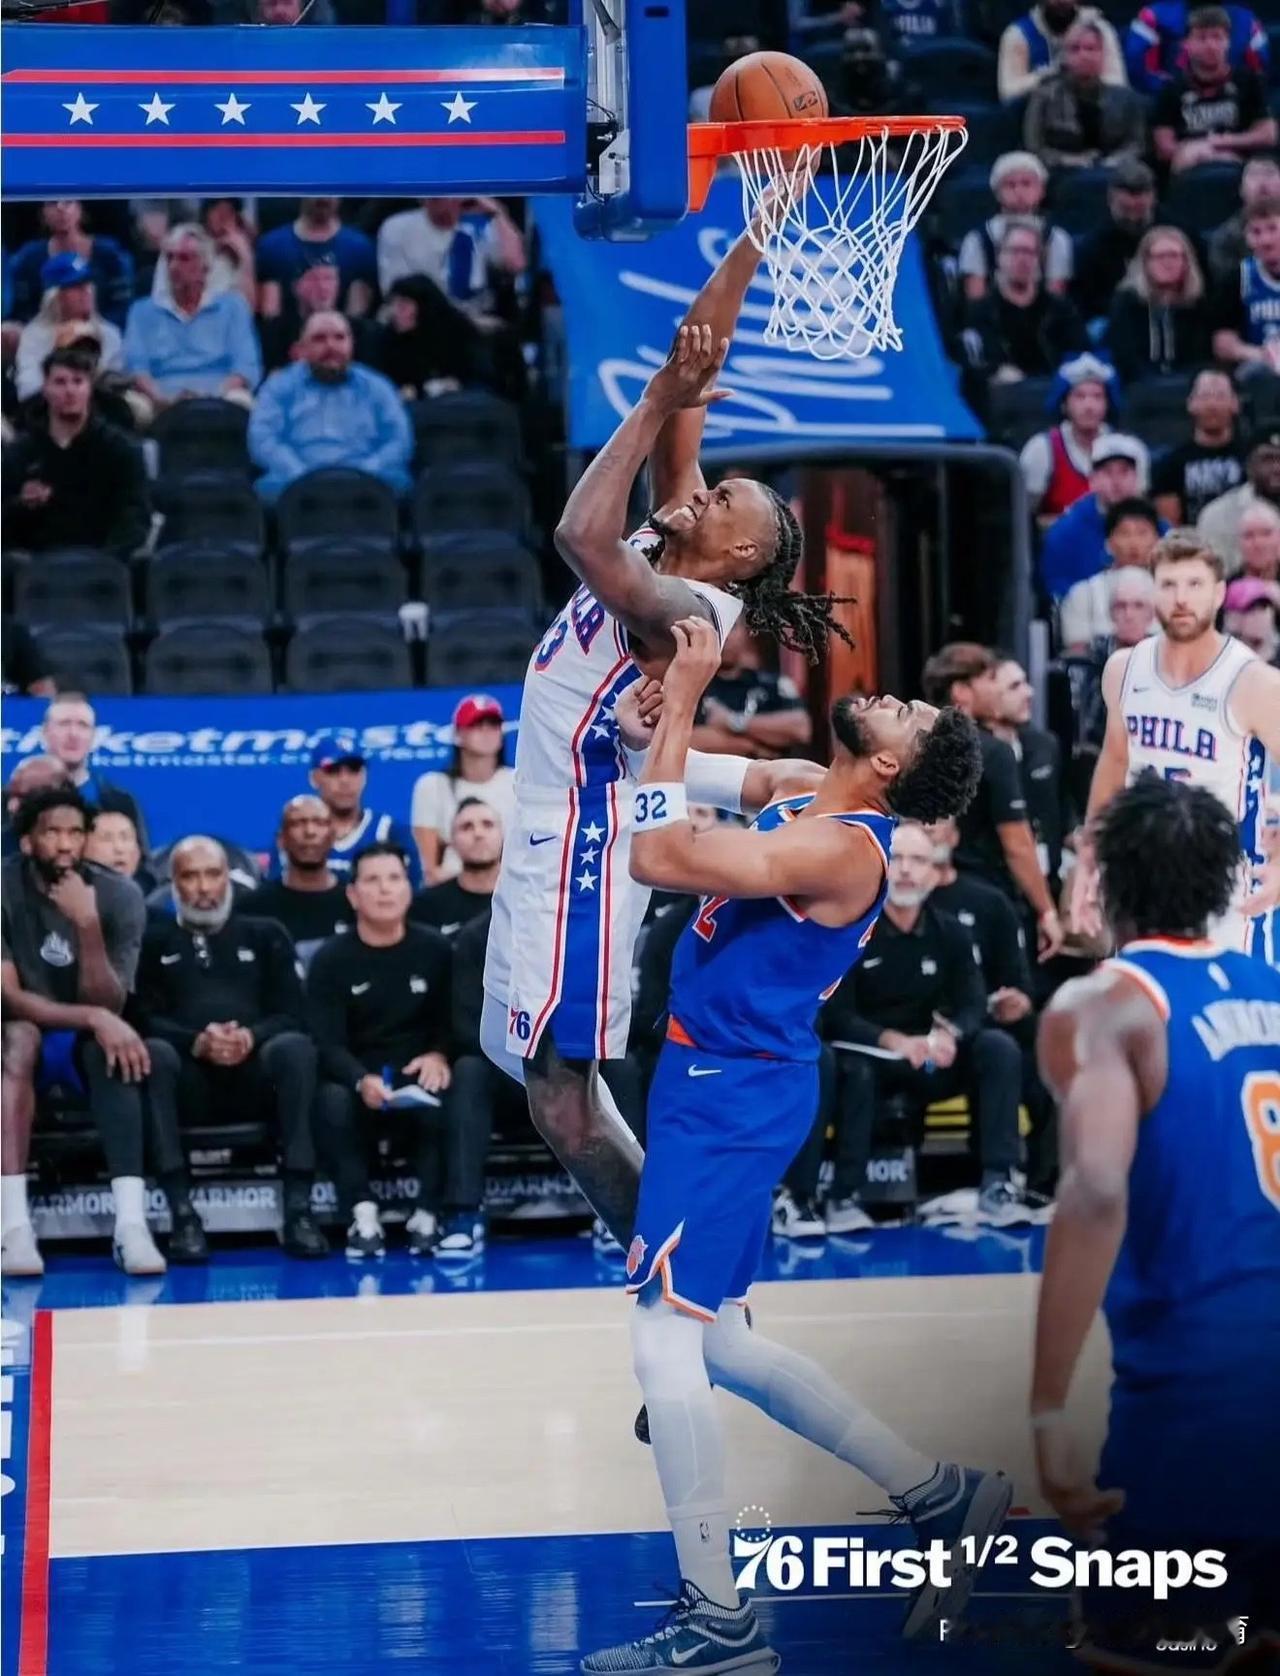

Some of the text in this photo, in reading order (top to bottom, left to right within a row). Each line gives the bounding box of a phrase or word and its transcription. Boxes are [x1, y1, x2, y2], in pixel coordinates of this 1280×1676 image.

[1126, 715, 1217, 762] PHILA
[634, 790, 668, 823] 32
[509, 1007, 531, 1041] 76
